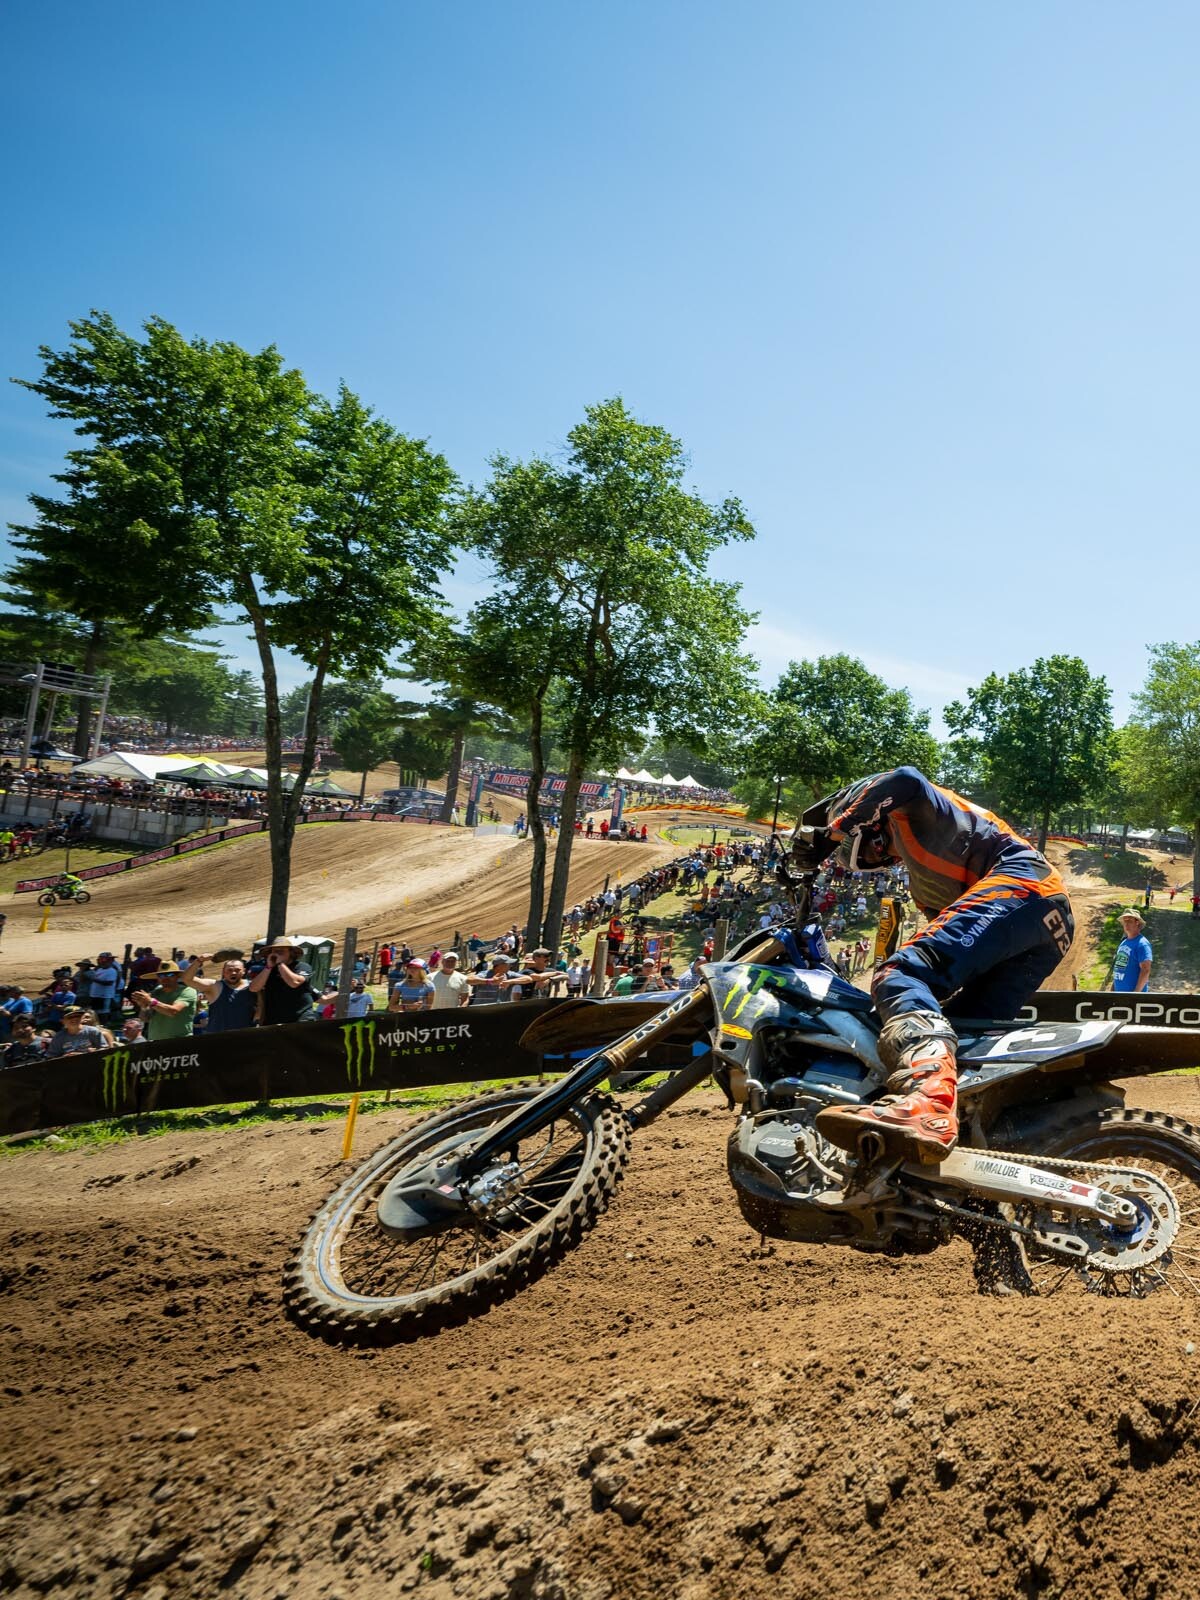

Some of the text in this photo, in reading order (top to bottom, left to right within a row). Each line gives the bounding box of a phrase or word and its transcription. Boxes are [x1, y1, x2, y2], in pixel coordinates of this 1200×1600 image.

[492, 773, 550, 790] MOTOSPT
[968, 902, 1008, 937] YAMAHA
[379, 1024, 472, 1047] MONSTER
[391, 1044, 456, 1057] ENERGY
[130, 1054, 200, 1074] MONSTER
[973, 1160, 1021, 1178] YAMALUBE
